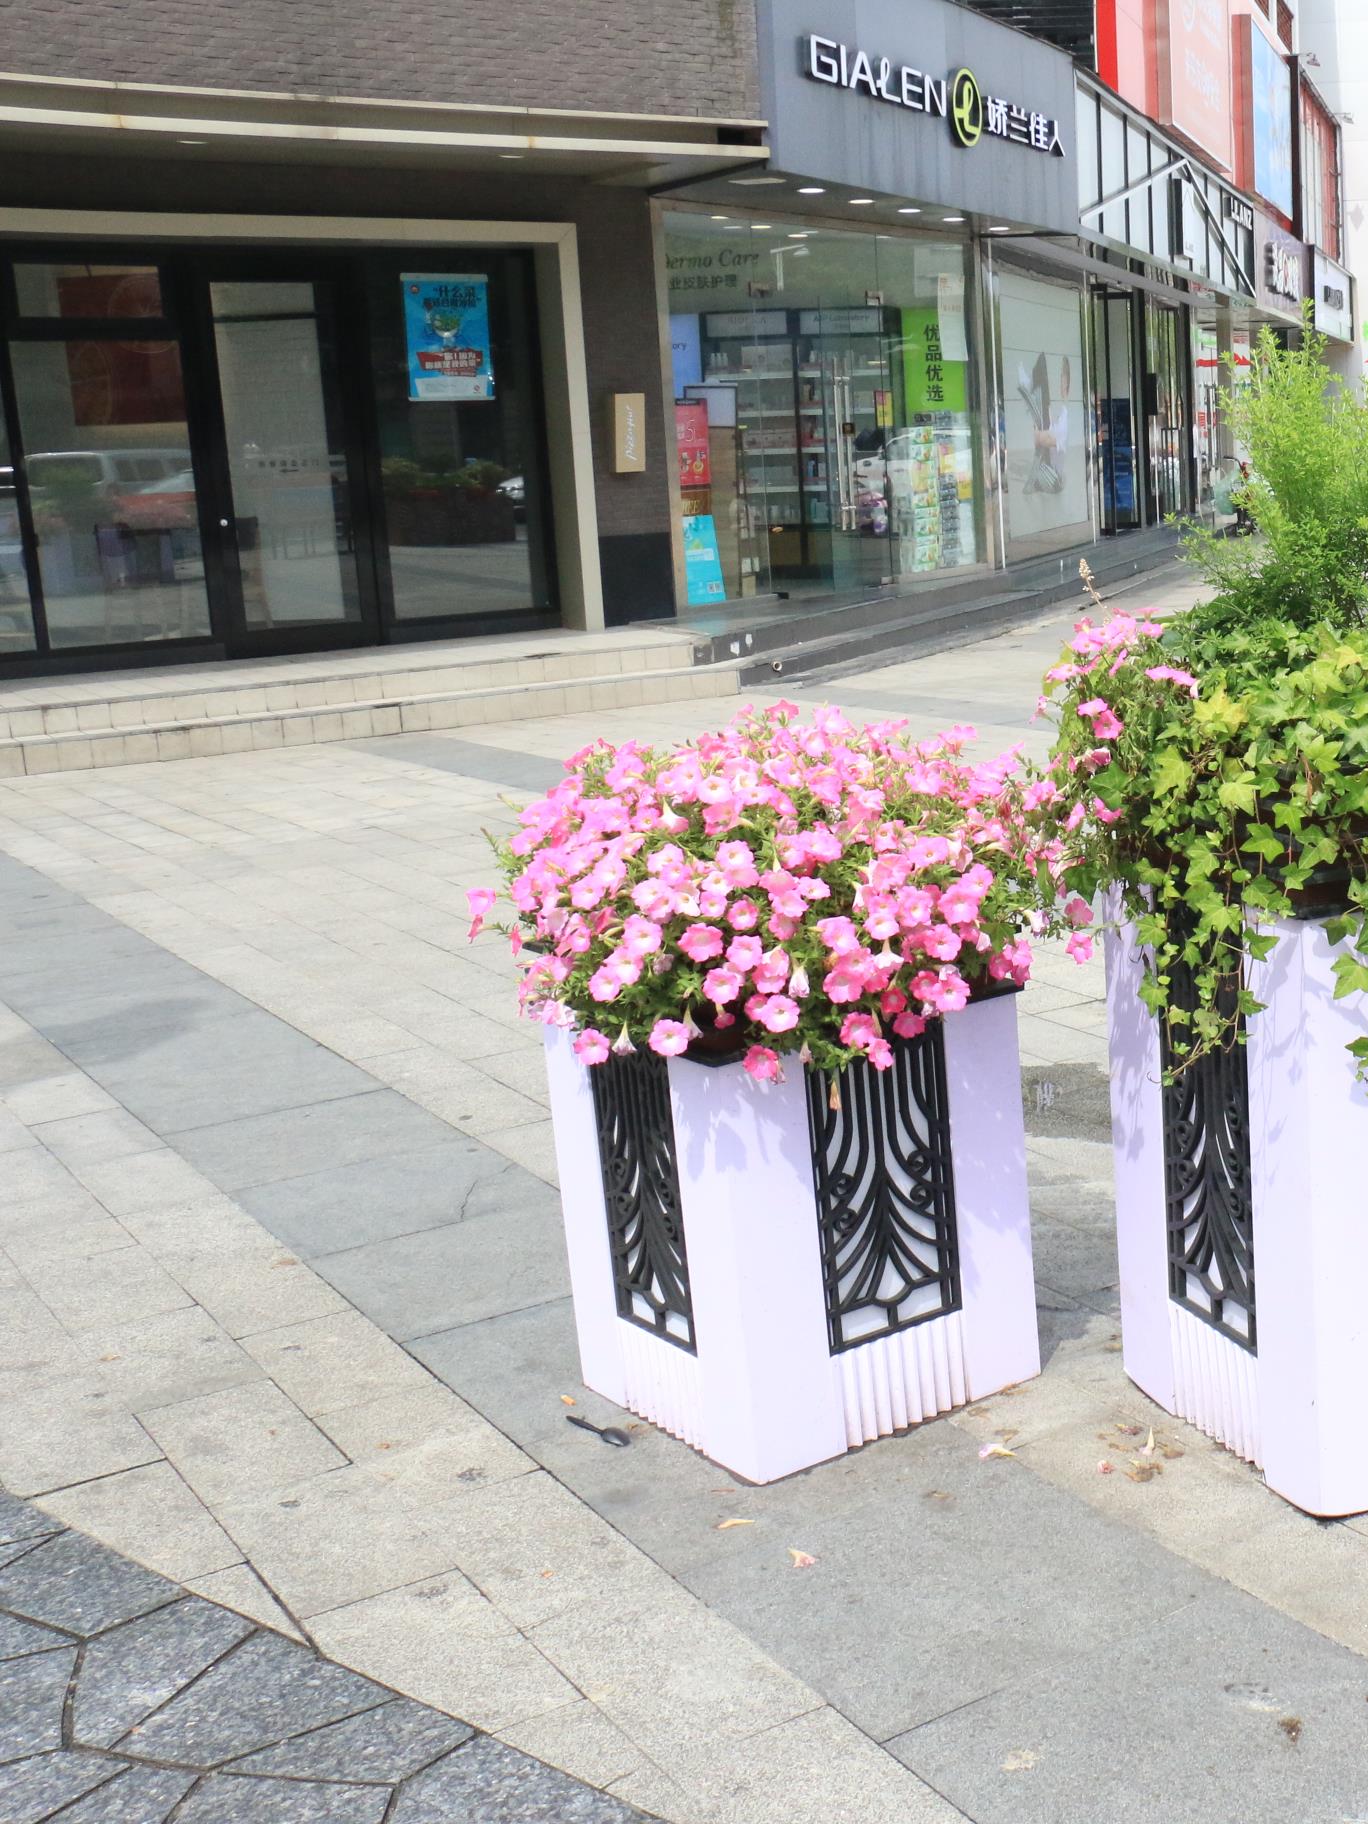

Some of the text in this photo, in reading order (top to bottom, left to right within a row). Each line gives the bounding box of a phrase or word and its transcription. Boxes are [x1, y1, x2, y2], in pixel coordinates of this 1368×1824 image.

[810, 34, 947, 117] GIALEN
[986, 95, 1066, 158] 娇兰佳人
[718, 249, 760, 267] Care
[922, 323, 945, 403] 优品优选
